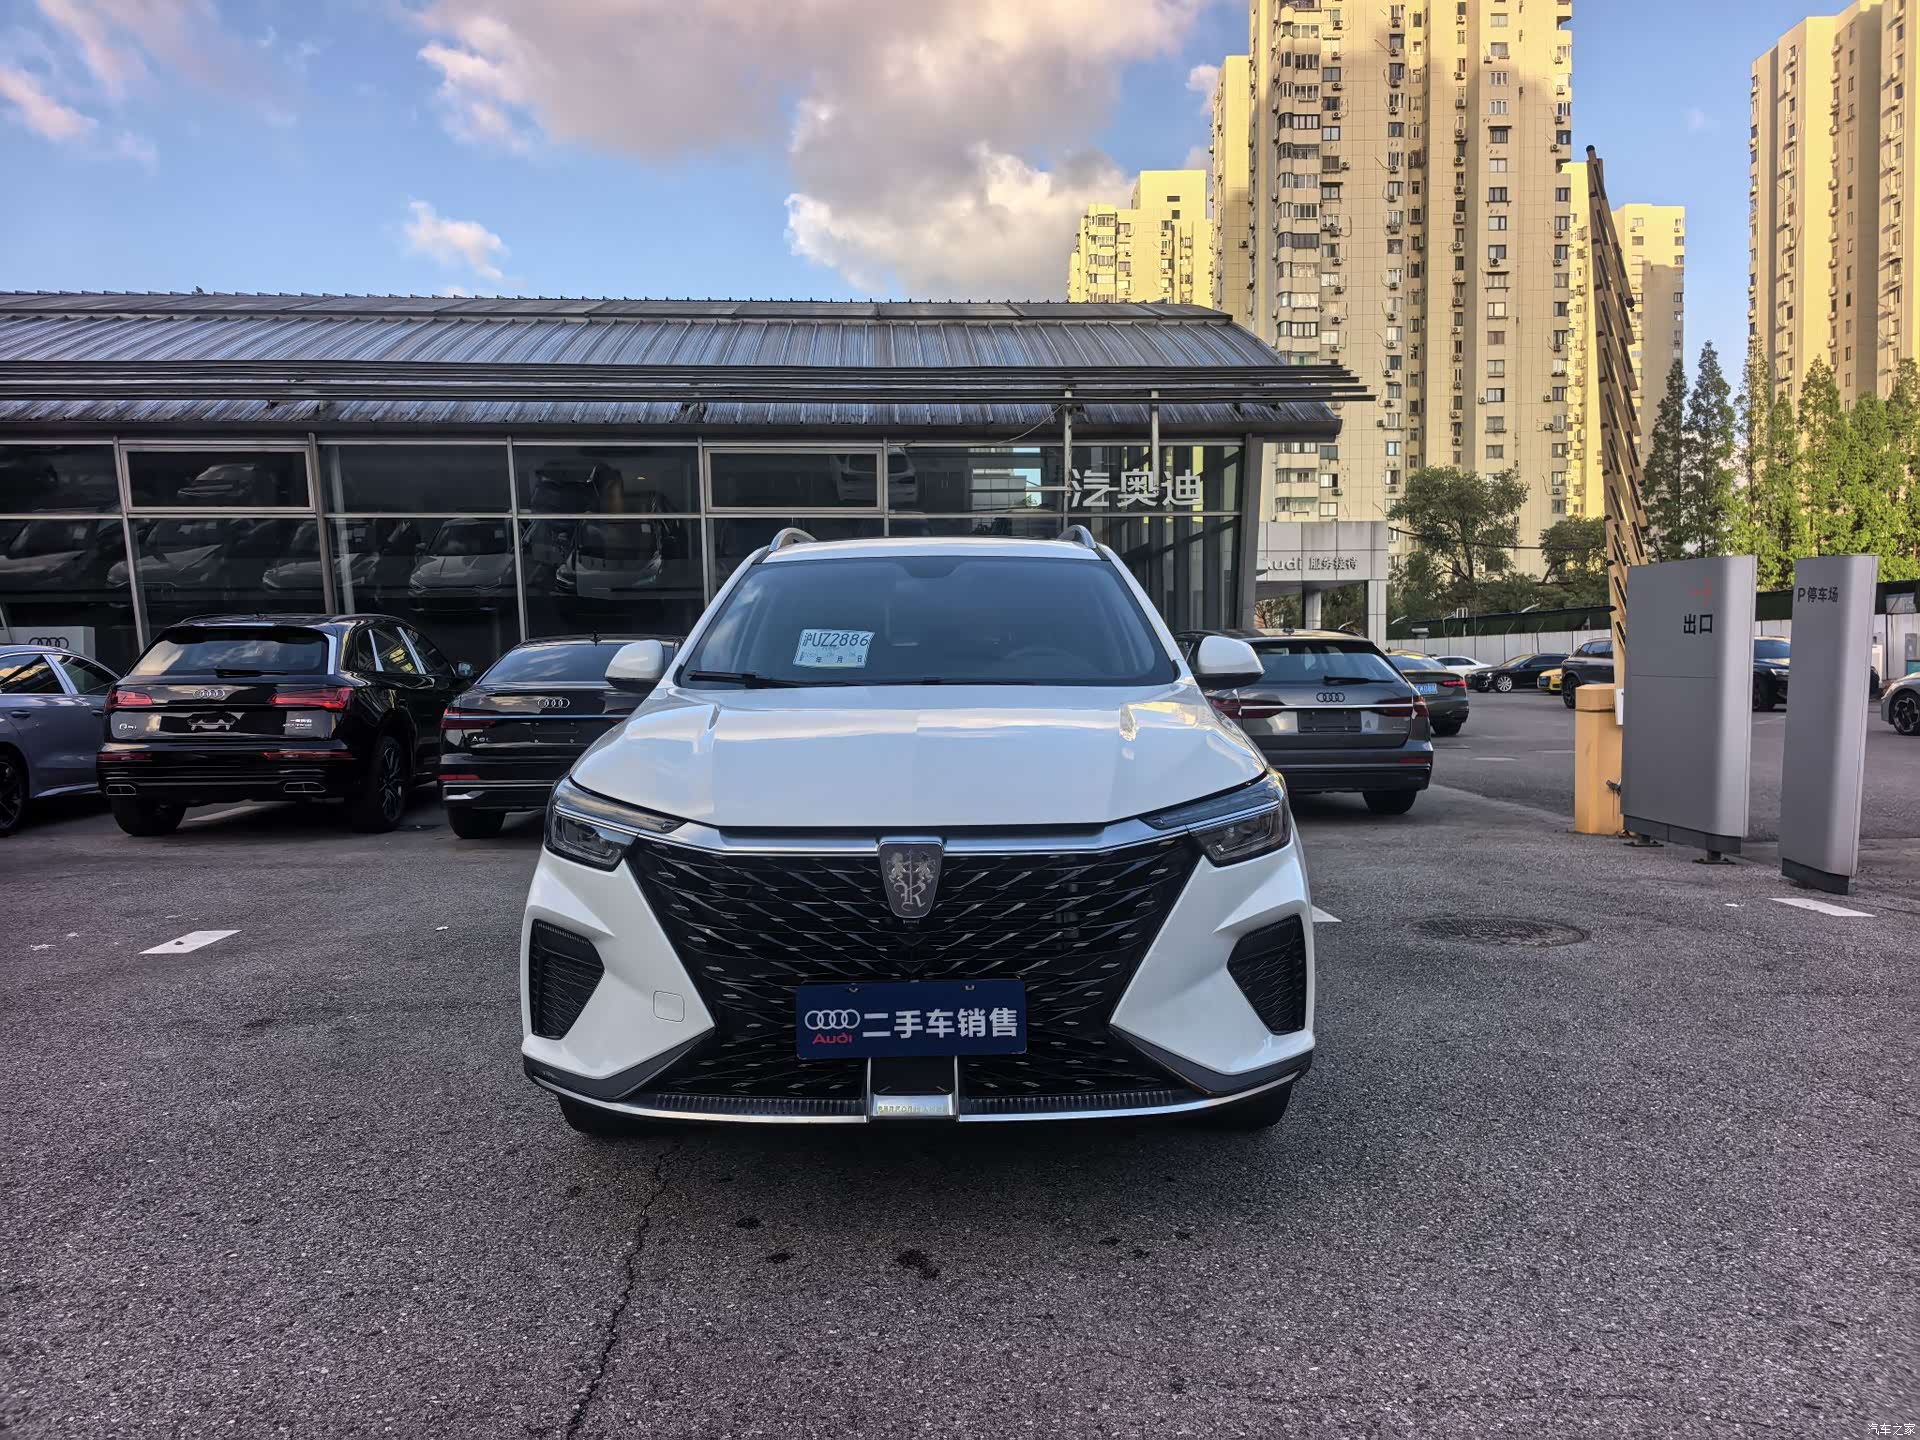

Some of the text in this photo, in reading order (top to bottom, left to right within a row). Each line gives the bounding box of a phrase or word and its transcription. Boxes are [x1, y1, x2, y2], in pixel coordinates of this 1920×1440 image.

[1071, 468, 1204, 508] 汽奥迪
[1683, 613, 1713, 635] 出口
[802, 632, 869, 647] 沪UZ2886
[862, 1007, 1018, 1039] 二手车销售
[812, 1032, 853, 1045] Audi
